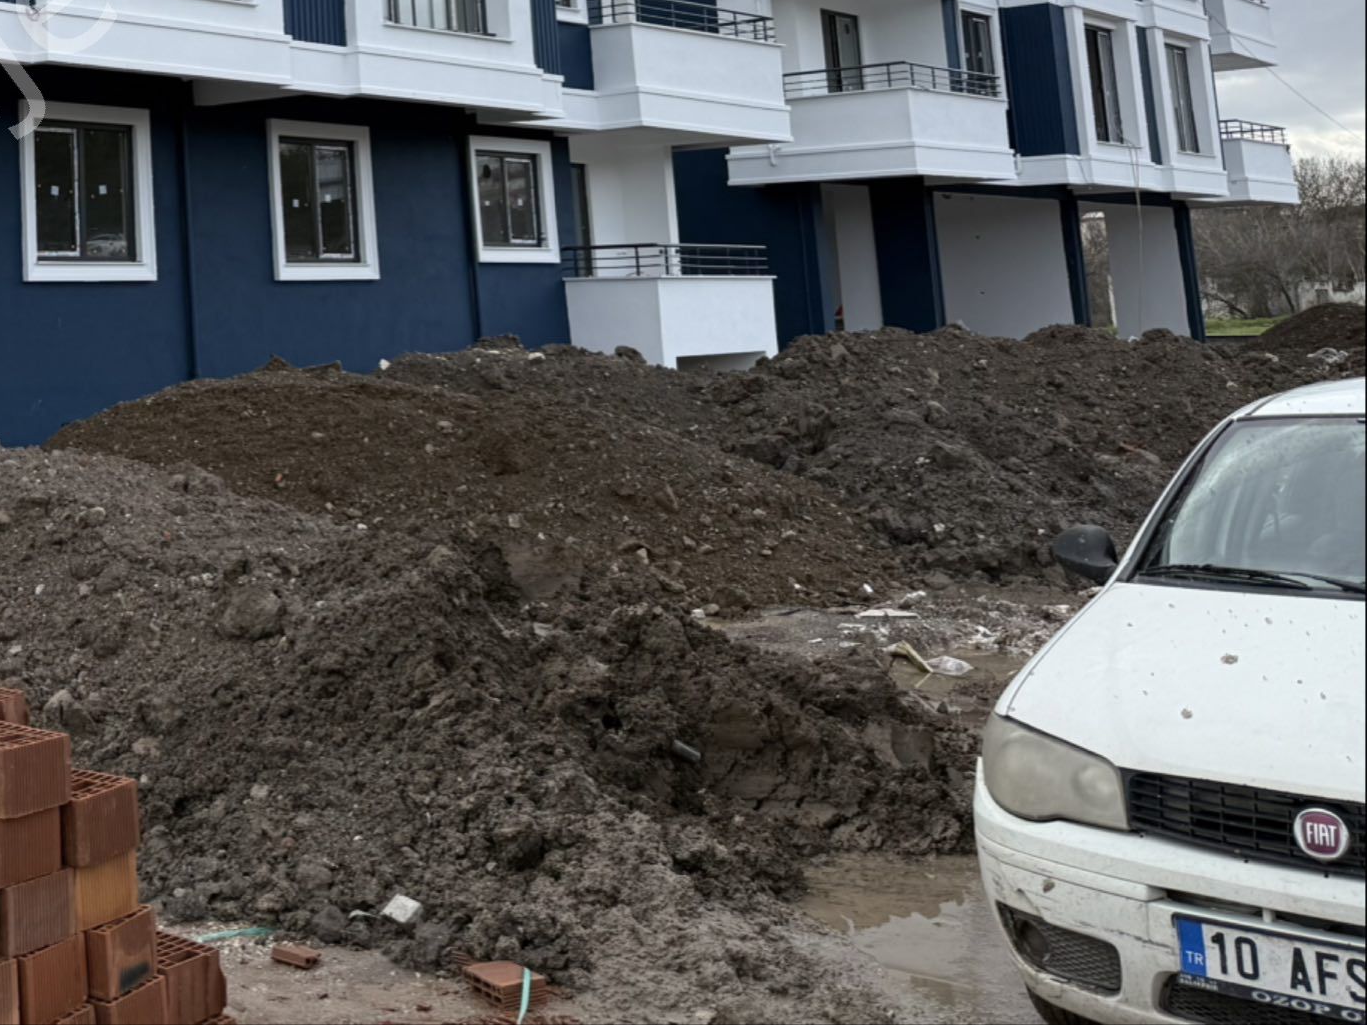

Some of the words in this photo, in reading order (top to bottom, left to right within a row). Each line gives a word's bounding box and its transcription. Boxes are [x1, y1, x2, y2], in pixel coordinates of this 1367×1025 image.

[1305, 821, 1338, 848] FIAT
[1184, 949, 1205, 966] TR
[1211, 931, 1260, 981] 10
